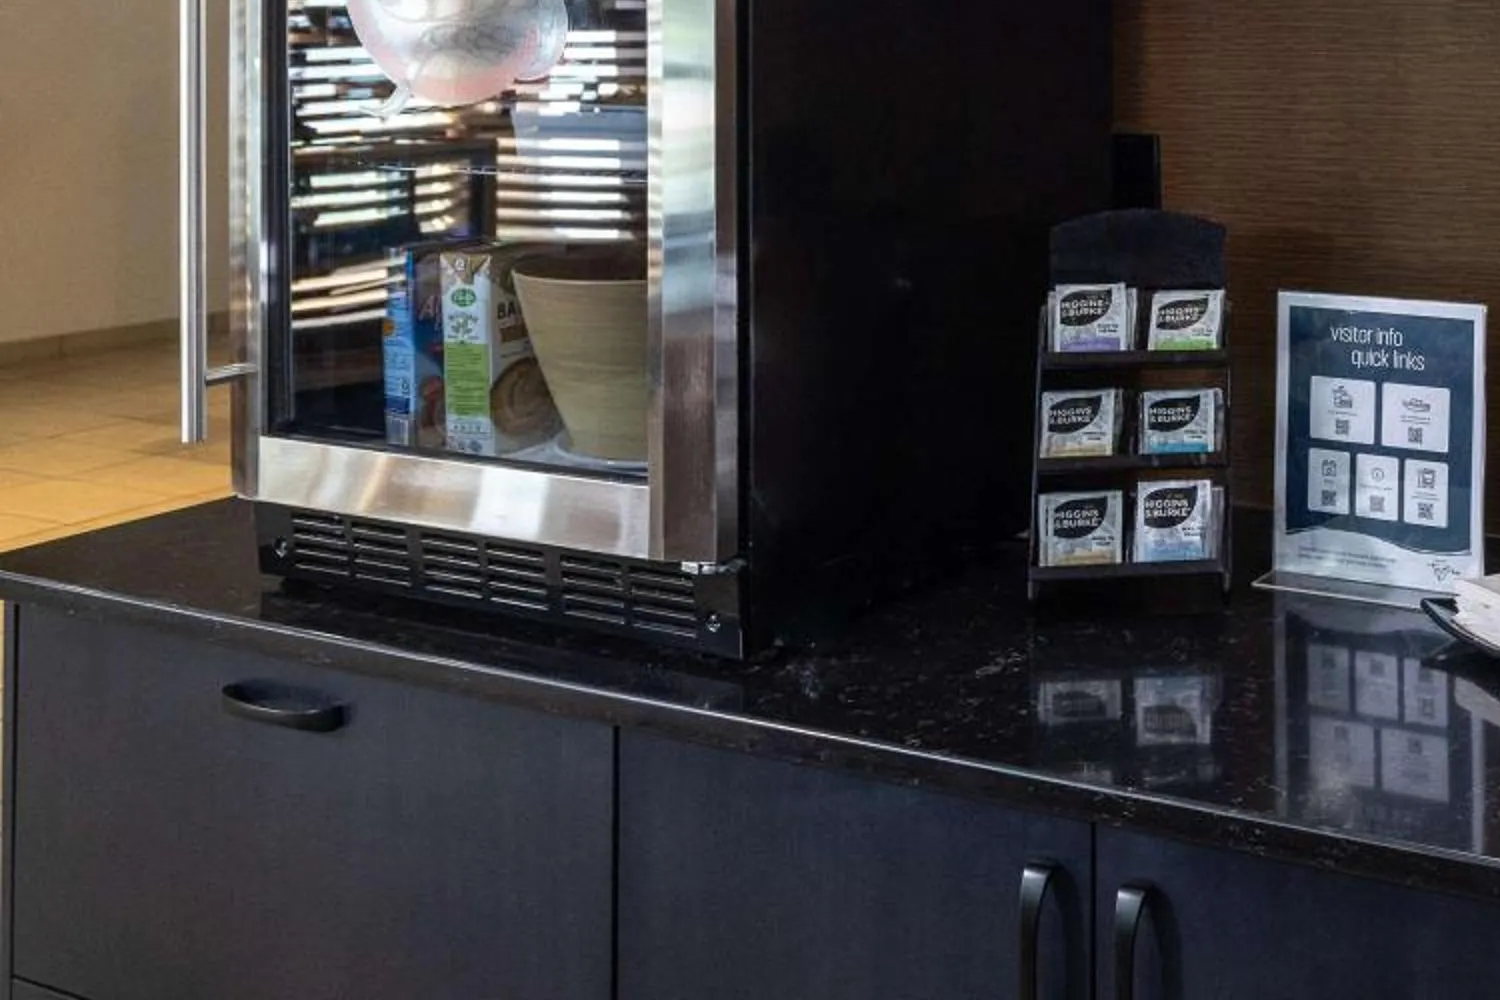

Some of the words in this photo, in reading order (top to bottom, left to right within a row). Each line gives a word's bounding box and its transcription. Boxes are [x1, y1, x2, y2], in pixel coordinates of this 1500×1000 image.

[1329, 325, 1373, 345] visitor
[1376, 326, 1403, 347] info
[1351, 347, 1389, 369] quick
[1393, 349, 1425, 371] links
